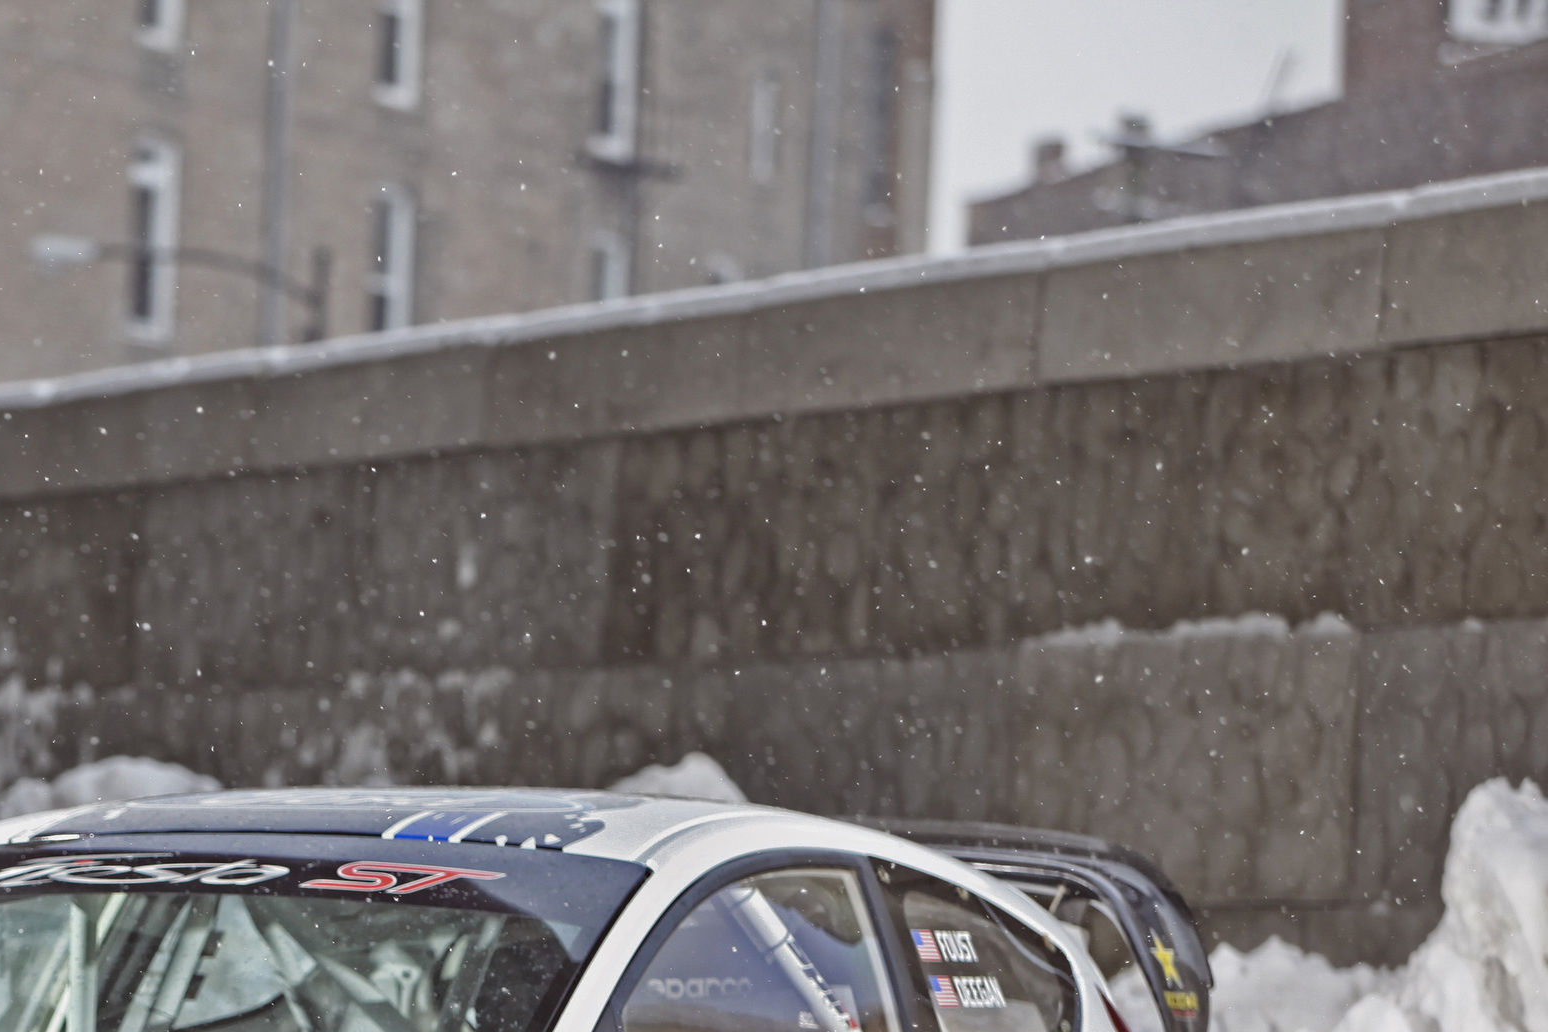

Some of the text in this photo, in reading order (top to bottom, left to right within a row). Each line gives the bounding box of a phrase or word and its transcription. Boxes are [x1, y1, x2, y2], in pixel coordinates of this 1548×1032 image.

[299, 860, 506, 895] ST
[933, 929, 979, 962] FOUST
[952, 975, 1007, 1009] DEEGAN
